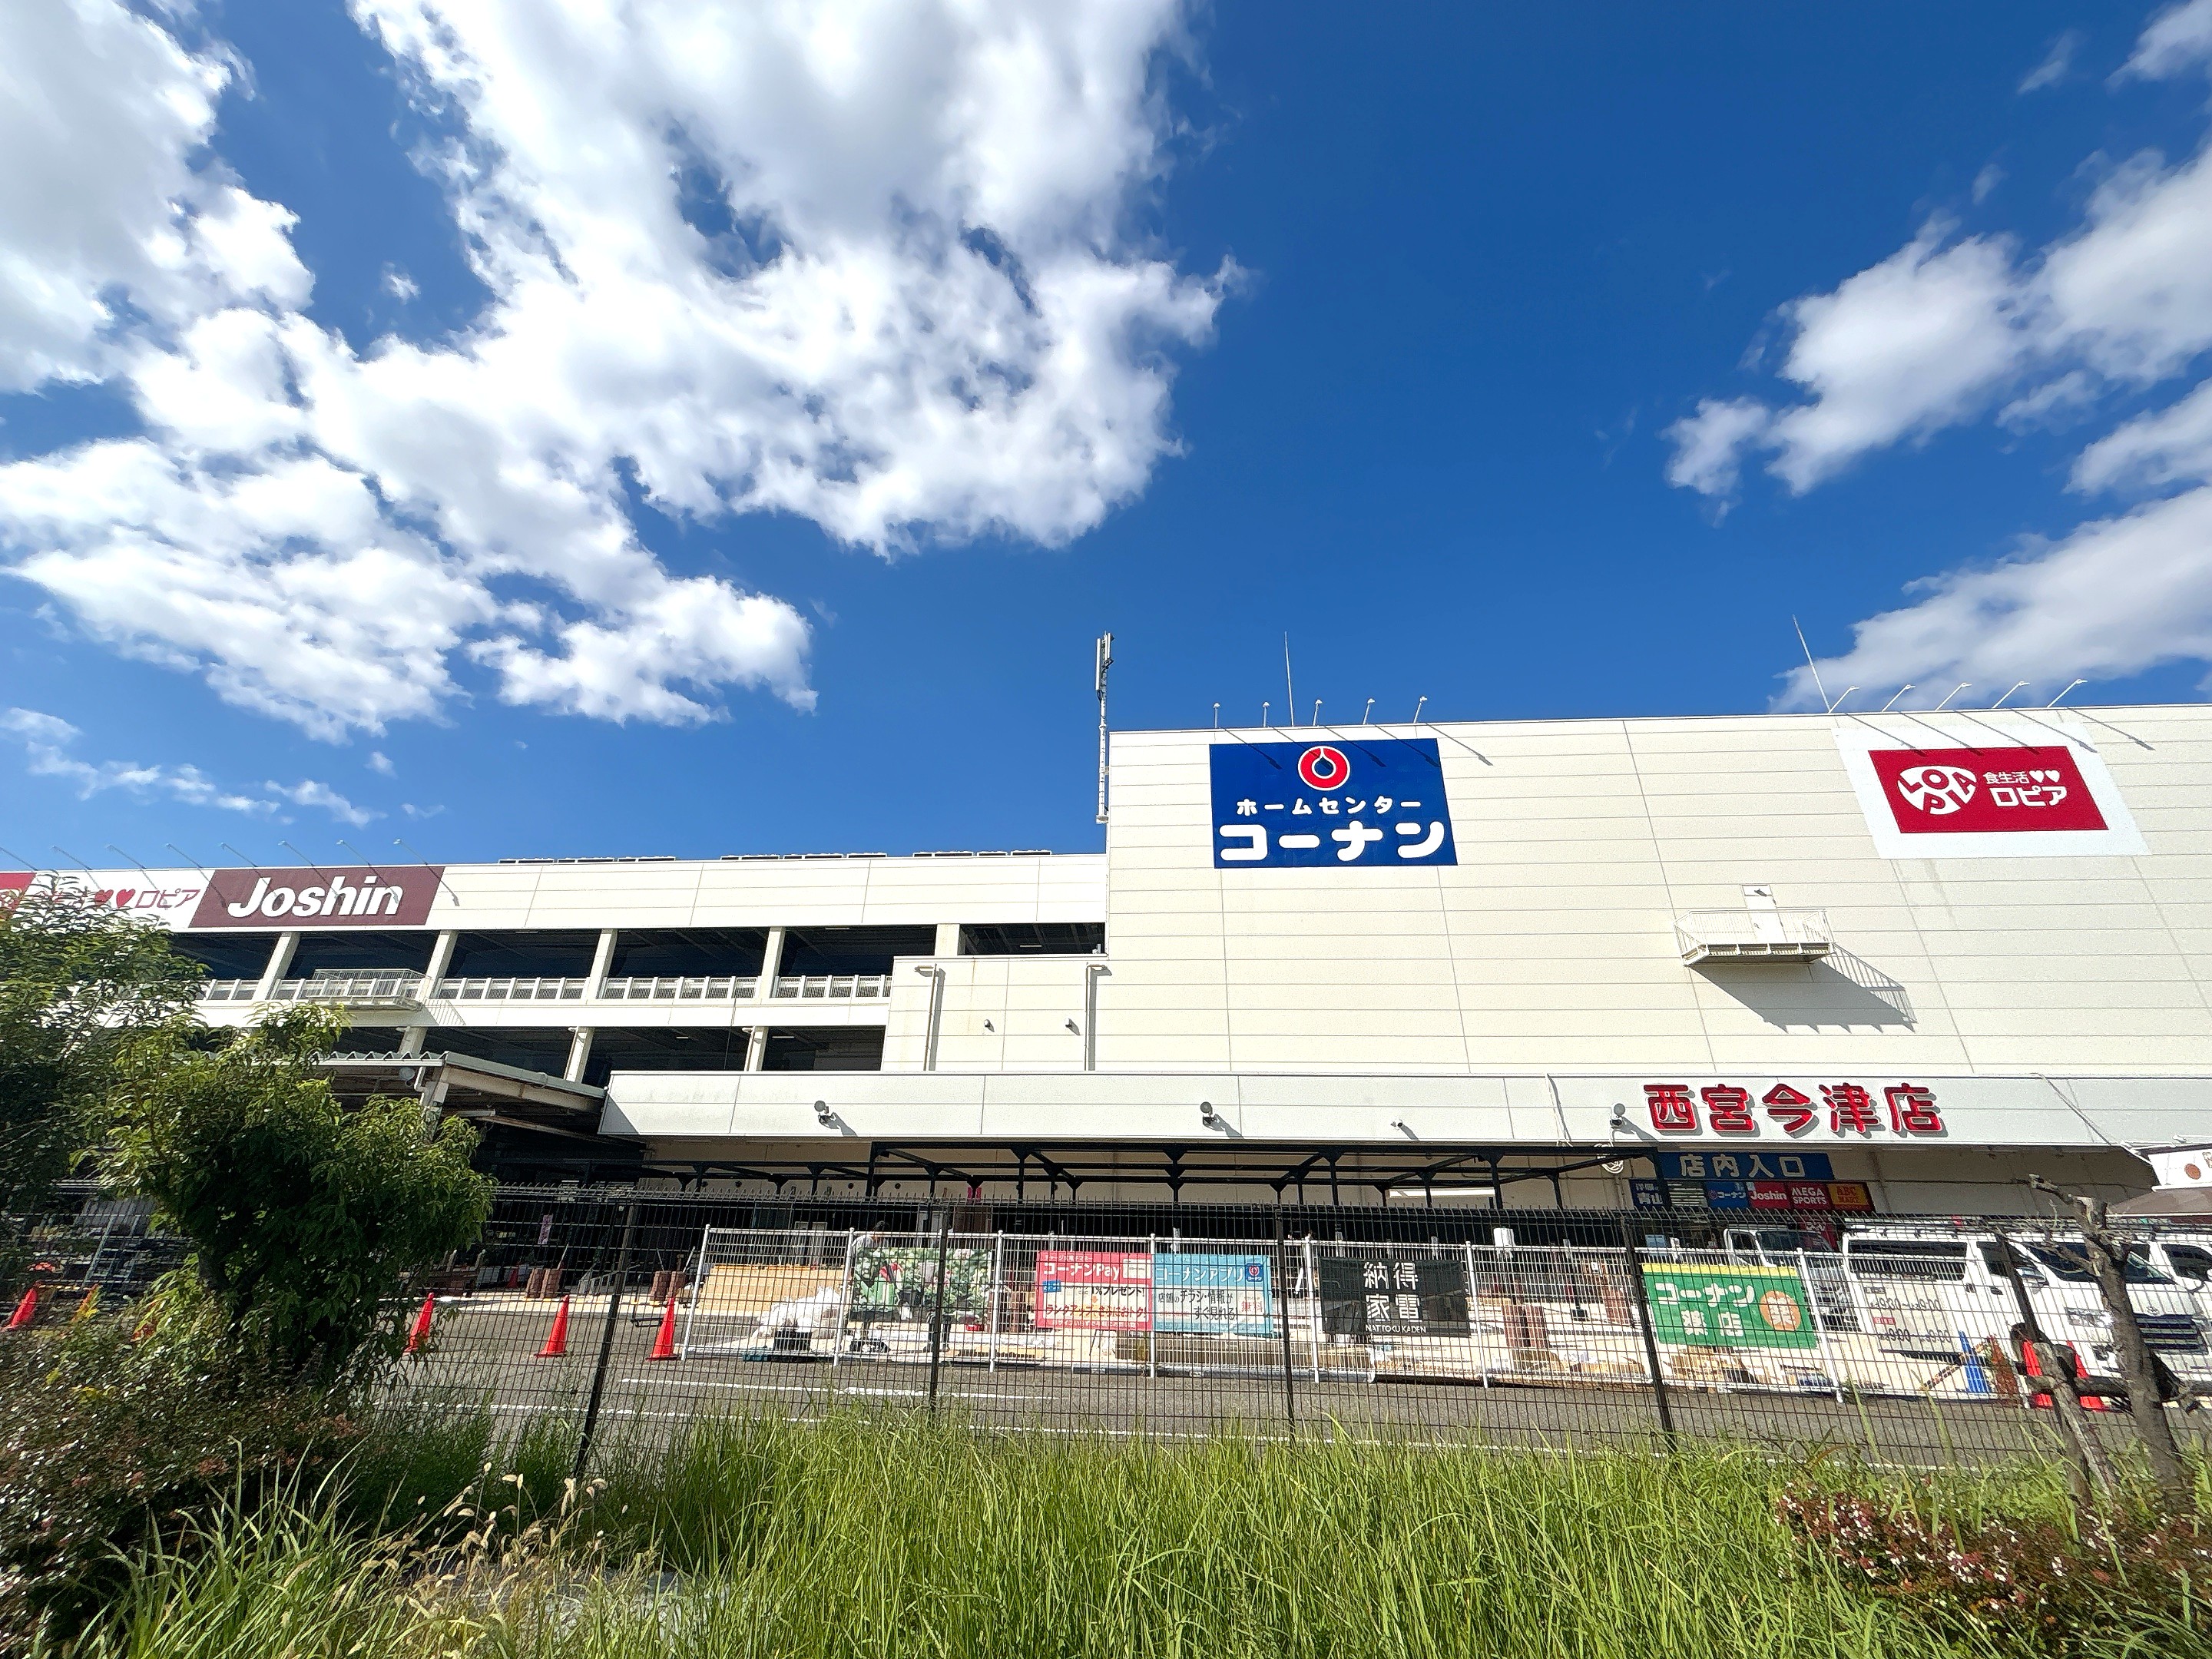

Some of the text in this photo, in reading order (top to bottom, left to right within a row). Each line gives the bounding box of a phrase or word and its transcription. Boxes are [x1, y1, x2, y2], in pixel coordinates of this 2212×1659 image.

[1982, 771, 2030, 784] 食生活
[1988, 785, 2068, 806] ロピア
[1237, 796, 1422, 816] ホームセンター
[1219, 820, 1445, 862] コーナン
[134, 888, 201, 909] ロピア
[227, 876, 403, 918] Joshin
[1643, 1083, 1944, 1134] 西宮今津店
[1679, 1154, 1806, 1178] 店内入口
[1637, 1192, 1664, 1204] 青山
[1750, 1191, 1787, 1200] Joshin
[1791, 1187, 1825, 1197] MEGA
[1793, 1197, 1827, 1205] SPORTS
[1043, 1262, 1119, 1280] コーナンPay
[1156, 1267, 1244, 1282] コーナンアプリ
[1363, 1262, 1419, 1290] 納得
[1654, 1283, 1755, 1308] コーナン
[1240, 1301, 1263, 1313] 無料
[1366, 1293, 1422, 1323] 家電
[1365, 1324, 1400, 1333] NATTOKU
